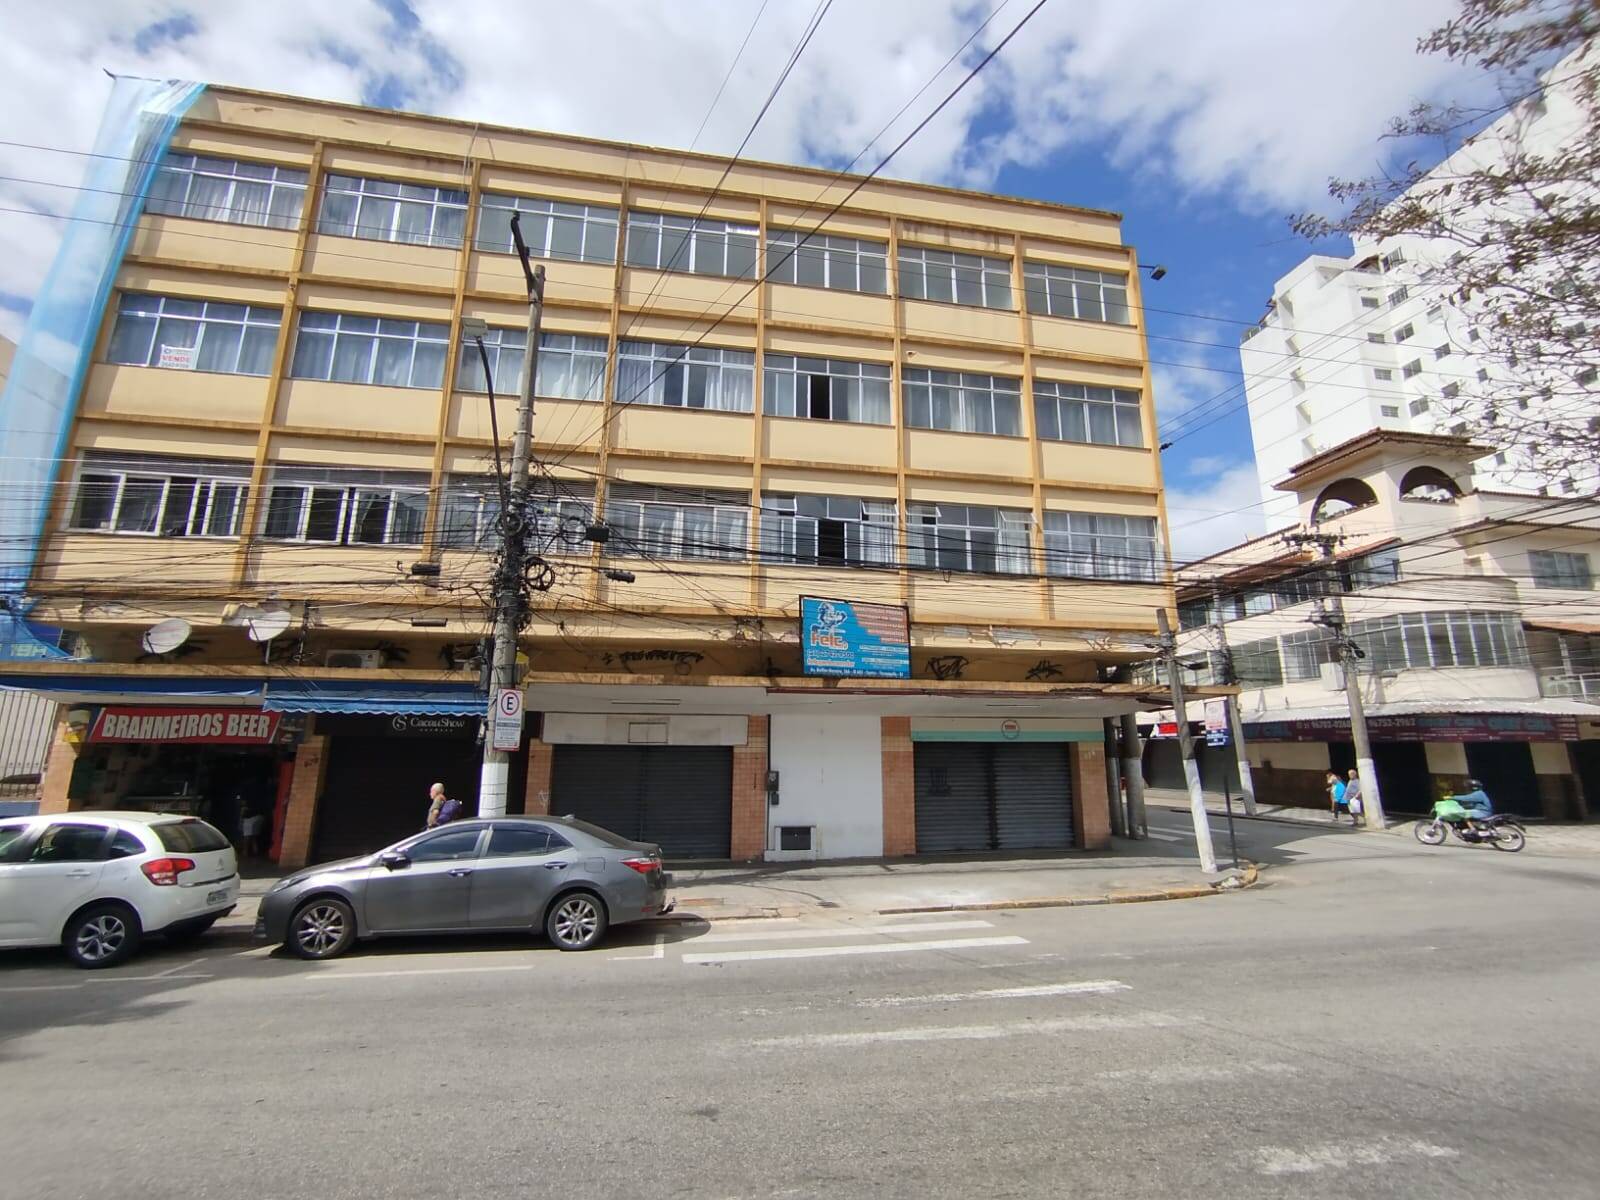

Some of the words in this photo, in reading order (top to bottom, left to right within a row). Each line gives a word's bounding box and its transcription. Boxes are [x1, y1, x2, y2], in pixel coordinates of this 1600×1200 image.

[506, 696, 514, 711] E
[101, 713, 224, 739] BRAHMEIROS
[226, 714, 271, 738] BEER
